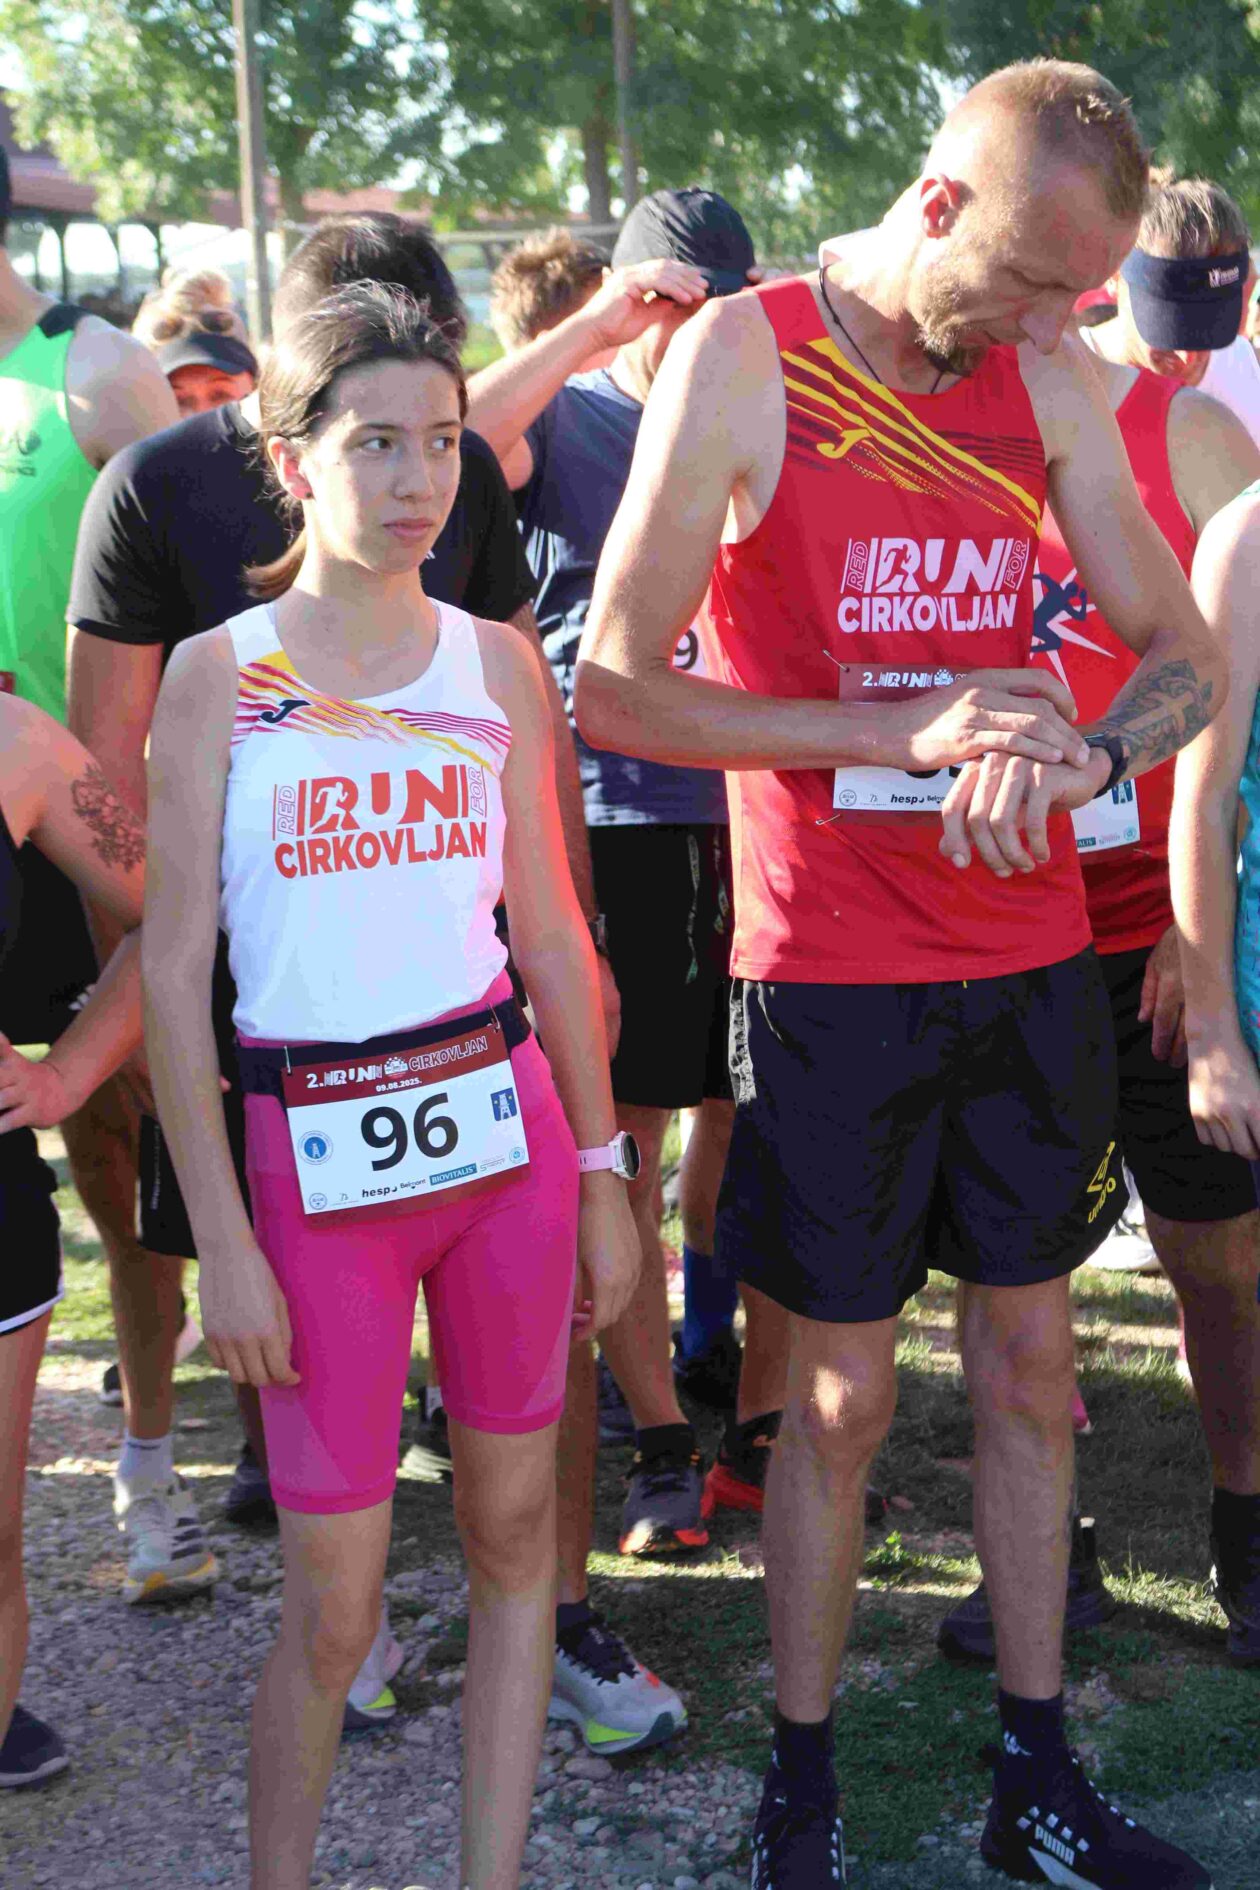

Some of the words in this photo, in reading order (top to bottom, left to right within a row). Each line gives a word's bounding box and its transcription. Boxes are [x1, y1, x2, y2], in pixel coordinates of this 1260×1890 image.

[846, 541, 869, 591] RED
[876, 538, 1006, 593] RUN
[1003, 540, 1028, 589] FOR
[837, 594, 1018, 632] CIRKOVLJAN
[862, 671, 878, 687] 2.
[277, 785, 297, 835] RED
[309, 765, 459, 834] RUN
[468, 767, 485, 816] FOR
[274, 821, 488, 879] CIRKOVLJAN
[306, 1073, 324, 1088] 2.
[408, 1036, 488, 1071] CIRKOVLJAN
[360, 1092, 459, 1172] 96
[1034, 1823, 1076, 1867] PUMA
